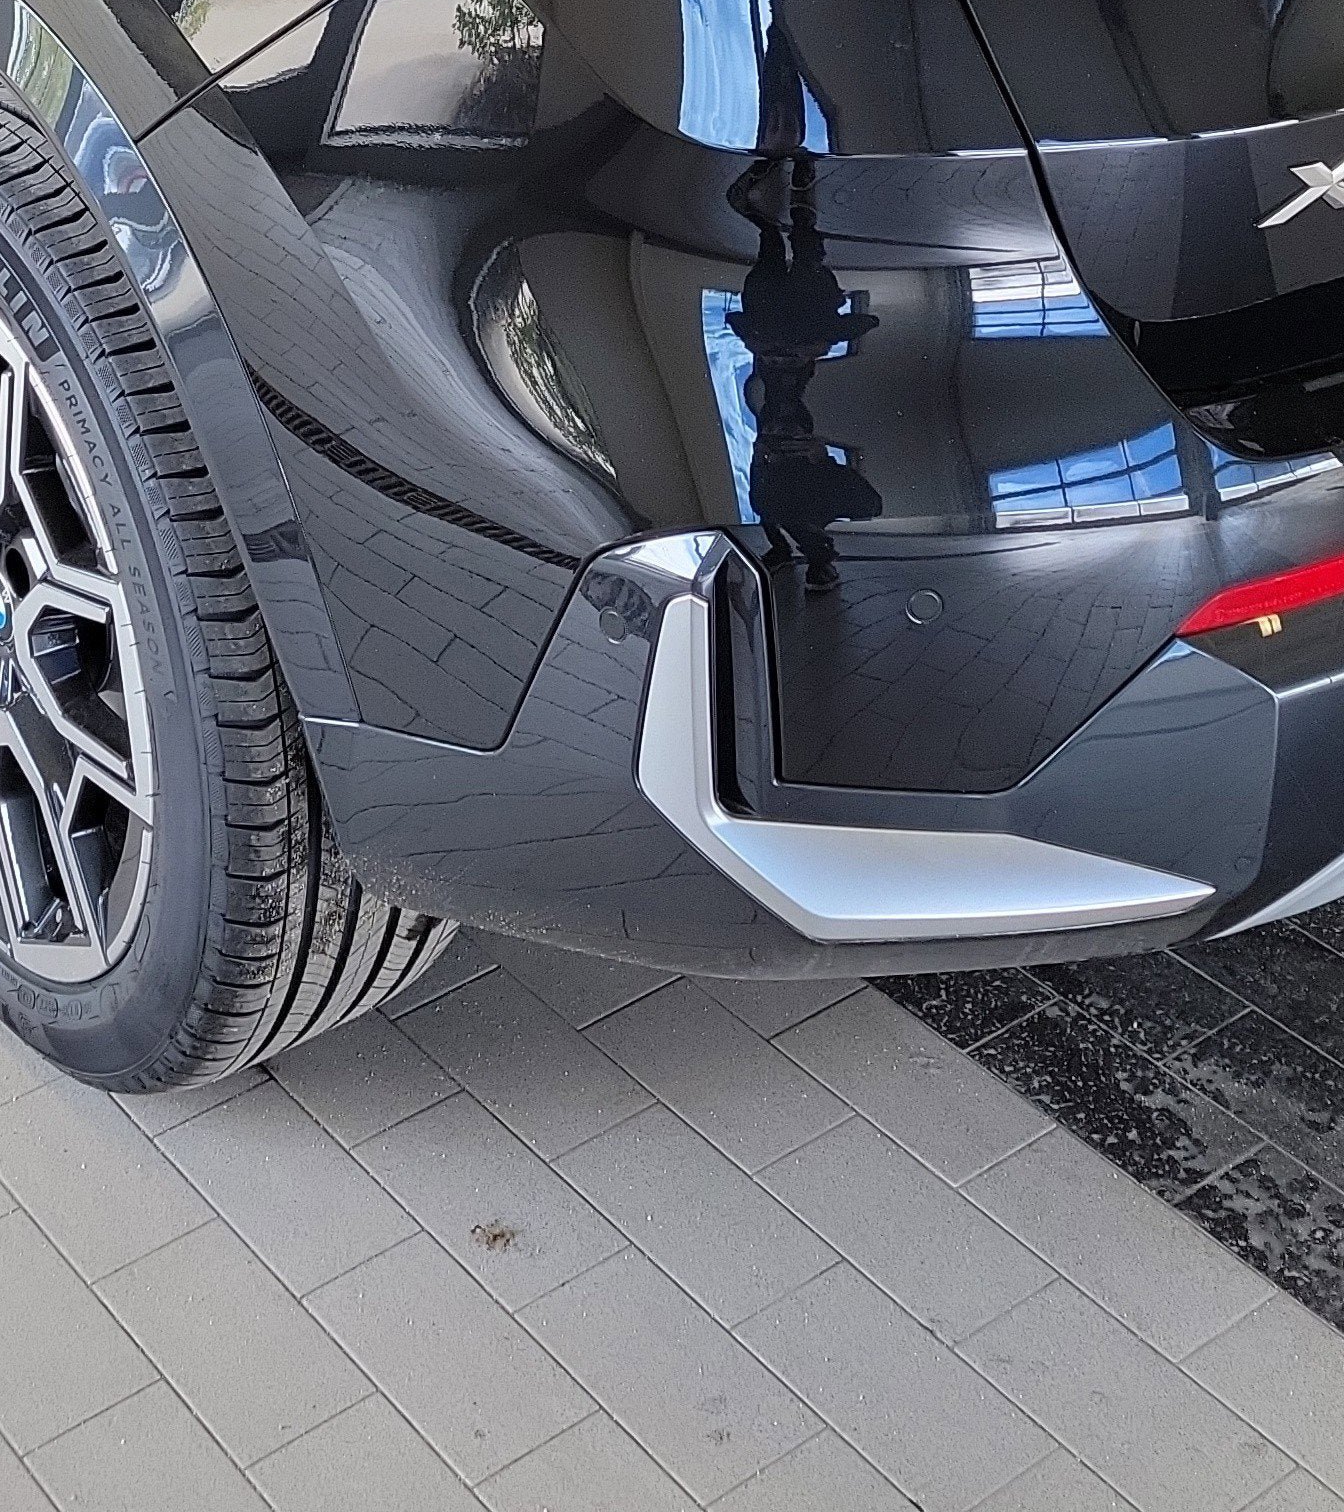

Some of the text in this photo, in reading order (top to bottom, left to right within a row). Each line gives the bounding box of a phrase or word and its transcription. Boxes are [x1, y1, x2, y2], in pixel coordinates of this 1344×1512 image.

[58, 379, 163, 679] PRIMACY ALL SEASON
